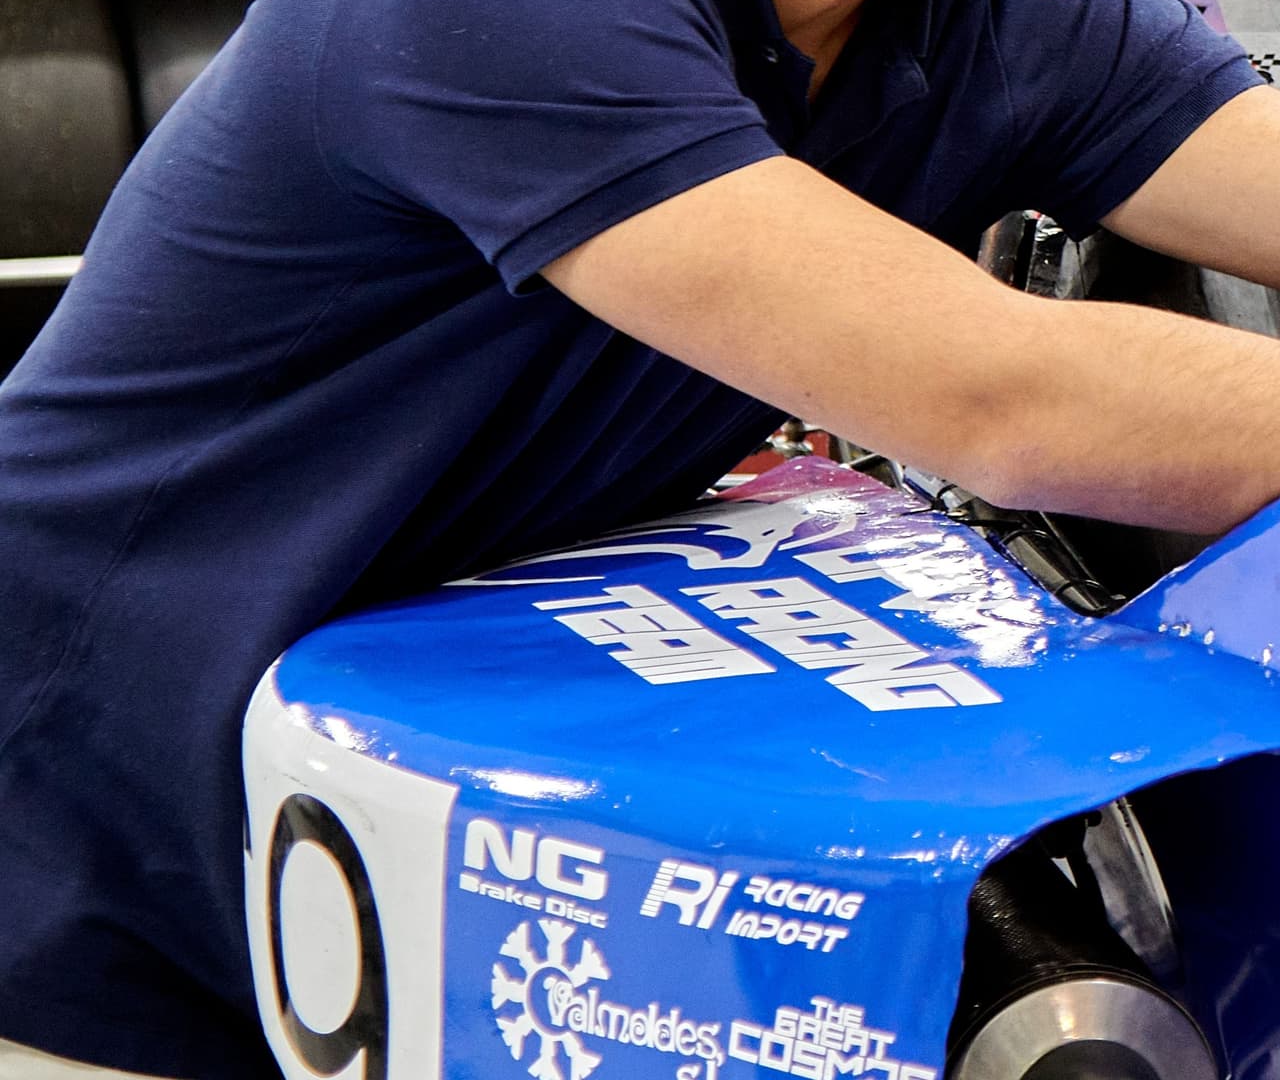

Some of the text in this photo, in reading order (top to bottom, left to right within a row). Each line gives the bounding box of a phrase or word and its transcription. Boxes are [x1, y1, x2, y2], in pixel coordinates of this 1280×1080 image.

[532, 584, 778, 685] TEAM
[679, 576, 1003, 712] RACING
[463, 819, 608, 901] NG
[458, 872, 608, 929] Brake Disc
[743, 875, 865, 921] RACING
[267, 793, 389, 1080] 9
[724, 908, 849, 954] IMPORT
[774, 1005, 897, 1061] GREAT
[810, 995, 865, 1029] THE
